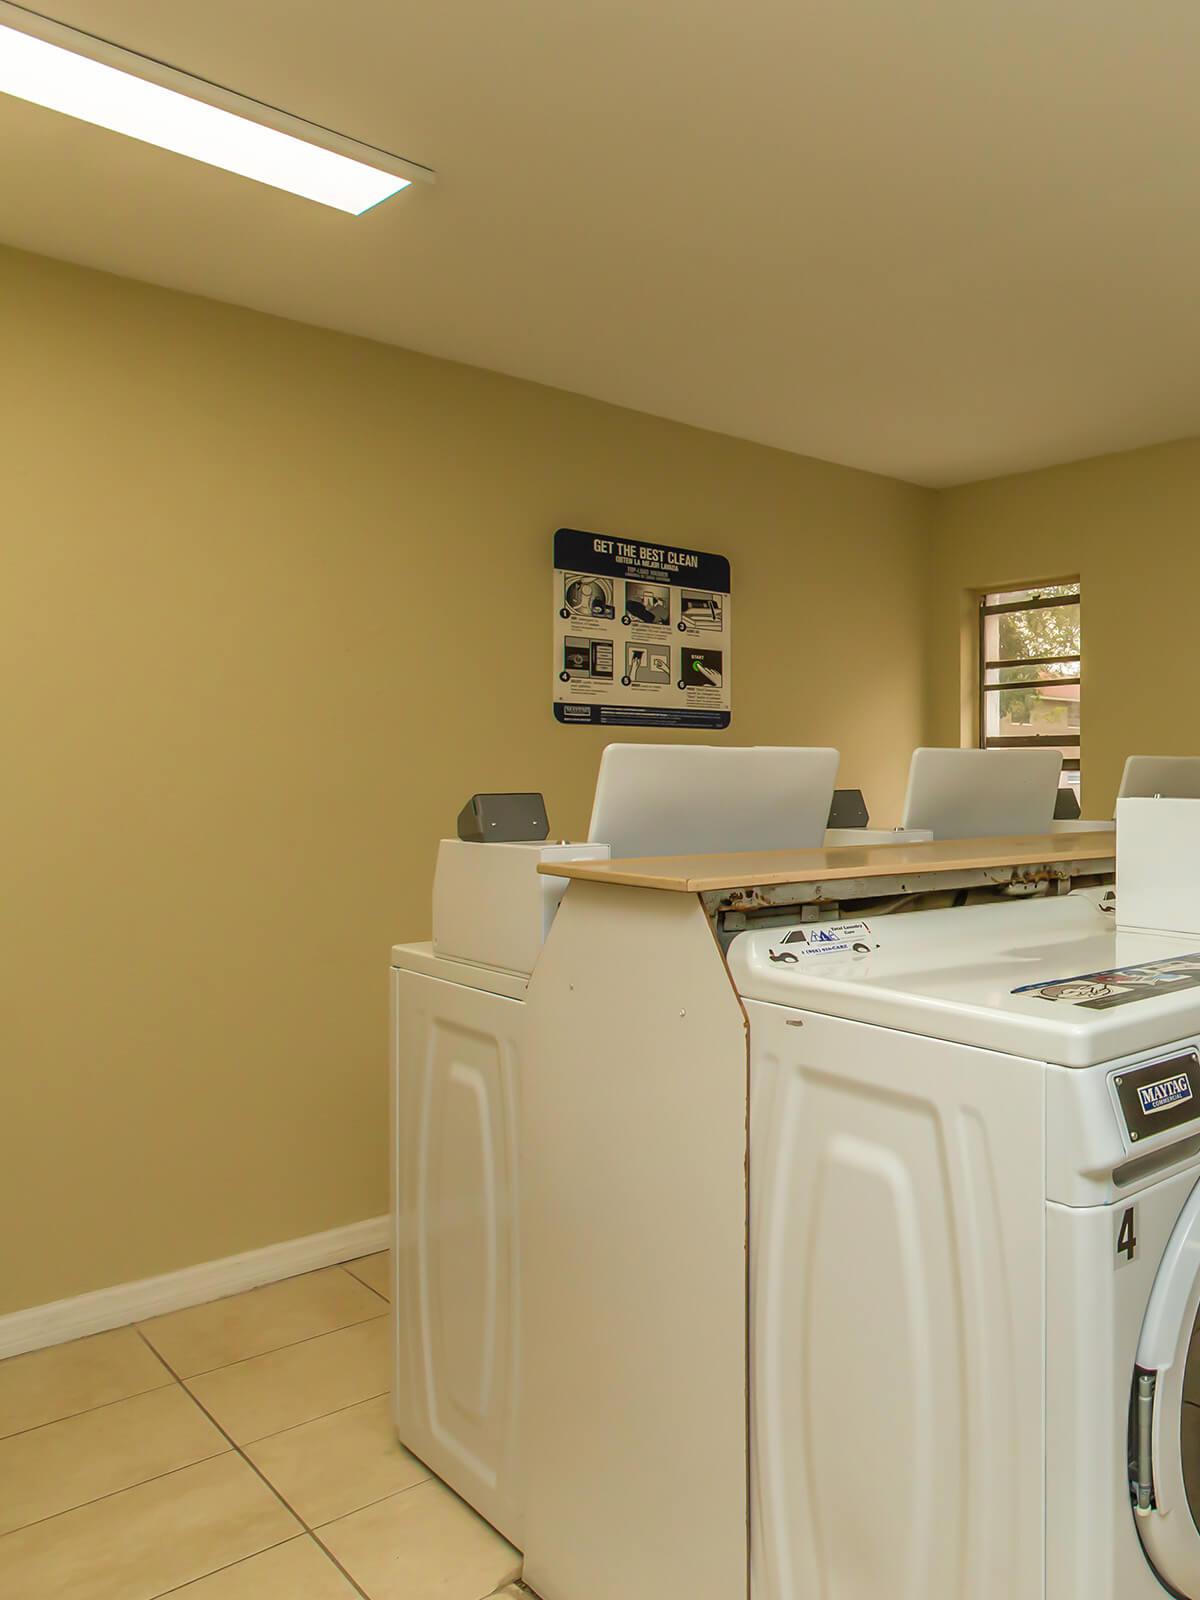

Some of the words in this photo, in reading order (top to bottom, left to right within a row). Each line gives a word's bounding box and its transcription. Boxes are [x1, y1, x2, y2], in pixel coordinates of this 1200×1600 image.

[593, 539, 614, 554] GET
[616, 542, 637, 558] THE
[639, 546, 665, 562] BEST
[667, 551, 698, 568] CLEAN
[1141, 1077, 1188, 1104] MAYTAG
[1152, 1093, 1183, 1108] COMMERCIAL
[1117, 1206, 1137, 1261] 4
